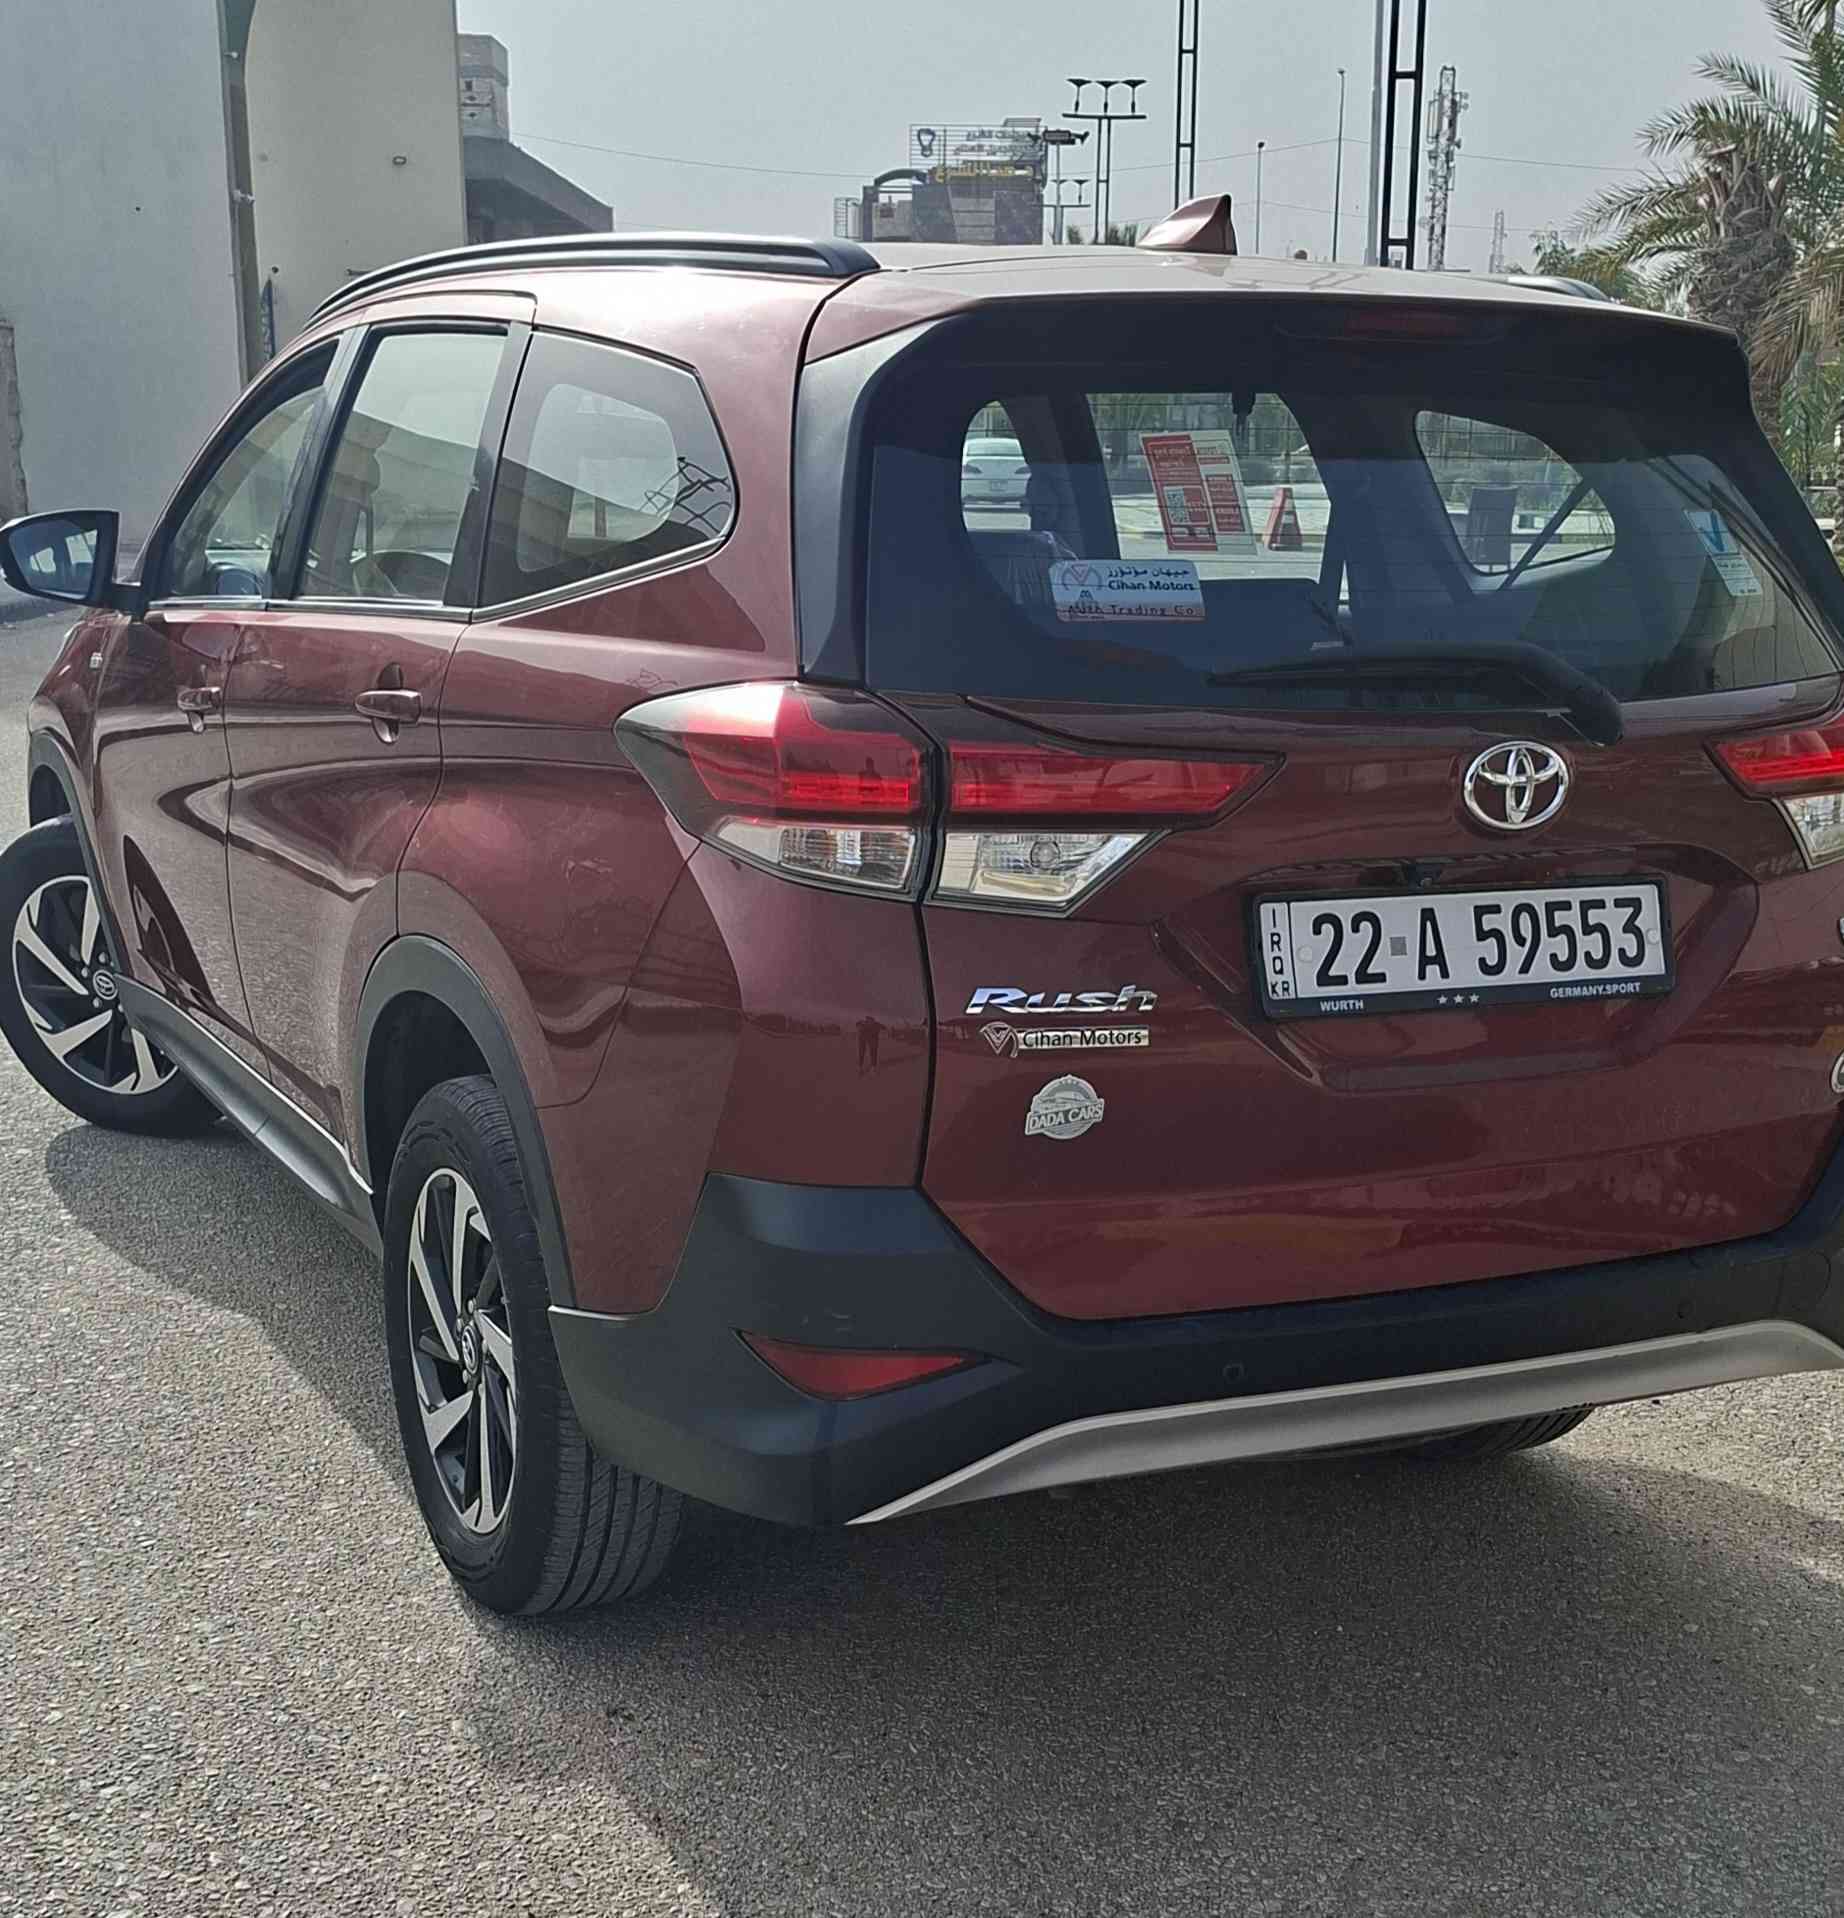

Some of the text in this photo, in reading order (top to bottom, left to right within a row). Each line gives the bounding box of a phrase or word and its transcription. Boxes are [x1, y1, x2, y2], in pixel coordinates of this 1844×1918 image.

[1107, 580, 1196, 592] Cihan Motors
[1311, 896, 1647, 988] 22 A 59553
[1269, 980, 1292, 998] KR
[964, 984, 1159, 1015] Rush
[1319, 999, 1365, 1013] WURTH
[1022, 1028, 1143, 1048] Cihan Motors
[1029, 1102, 1105, 1131] DADA CARS
